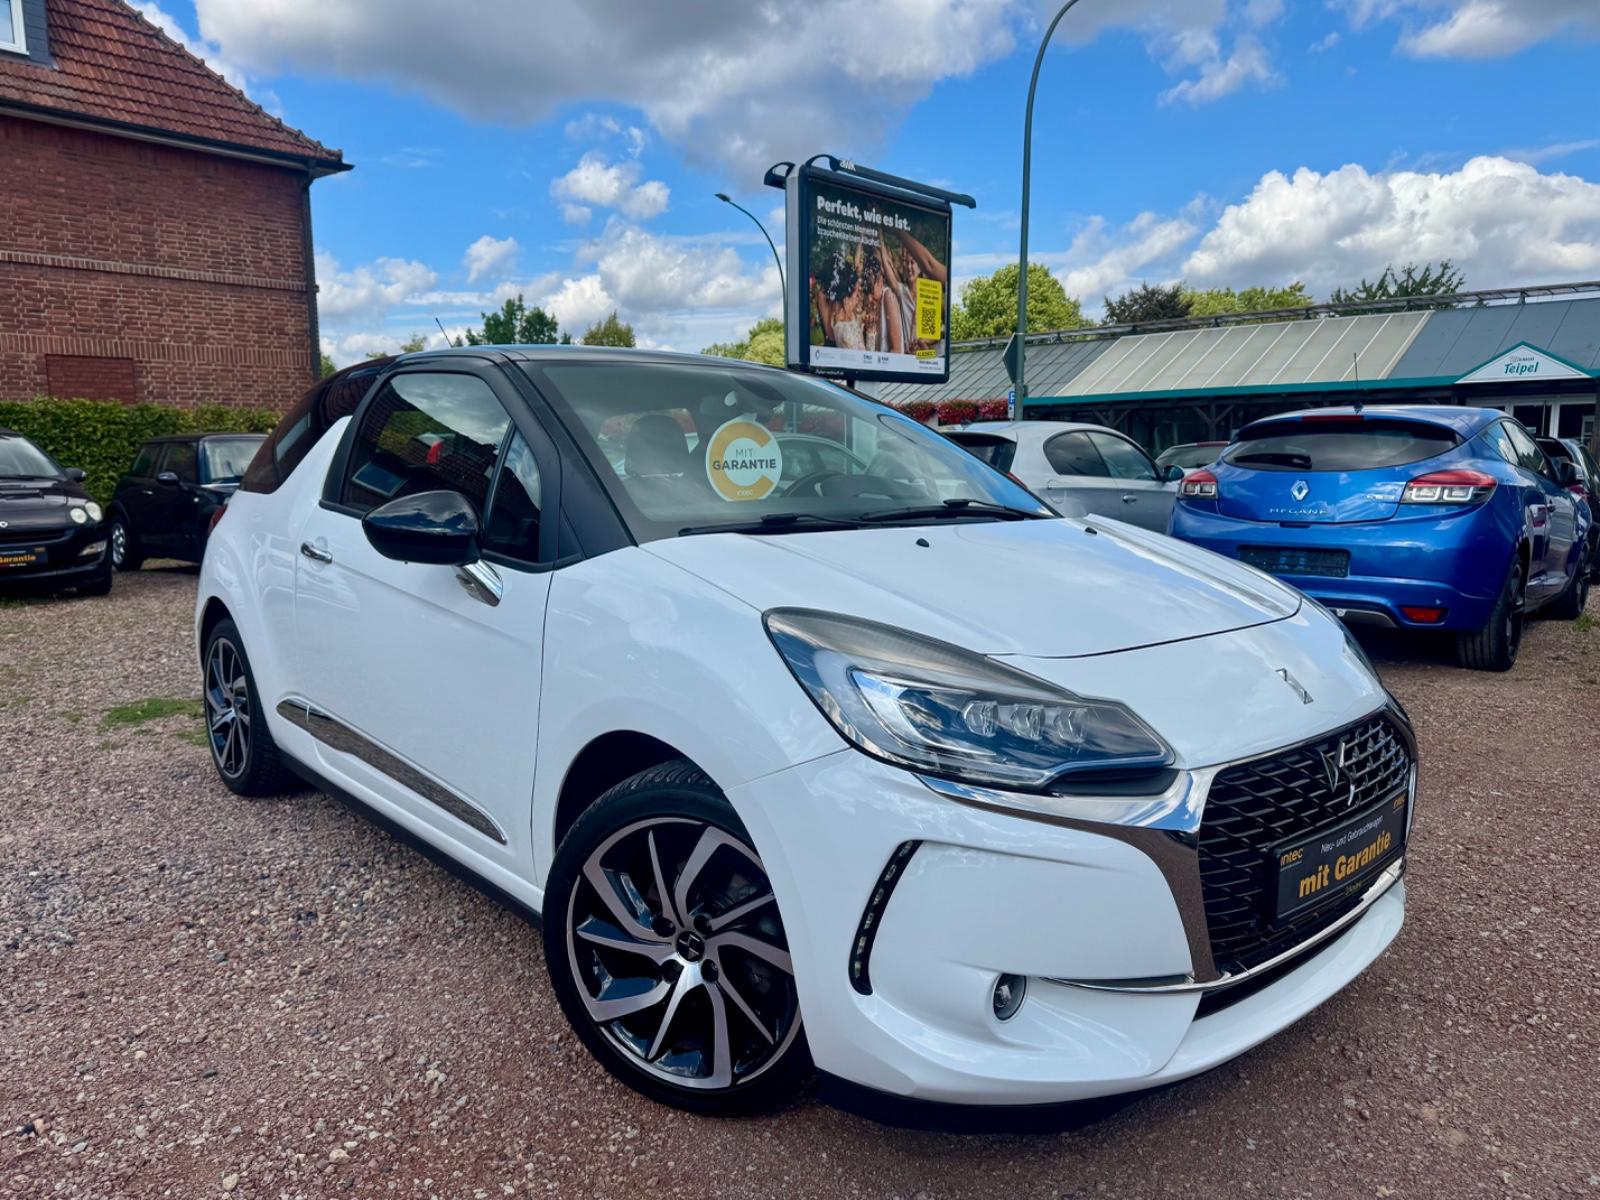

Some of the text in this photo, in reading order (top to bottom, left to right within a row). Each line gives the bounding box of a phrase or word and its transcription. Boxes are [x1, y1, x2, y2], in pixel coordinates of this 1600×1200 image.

[817, 195, 911, 231] Perfekt, wie es ist.
[1504, 361, 1539, 375] Teipel
[735, 448, 754, 458] MIT
[712, 458, 777, 471] GARANTIE
[1320, 843, 1335, 854] Neu-
[1336, 834, 1347, 847] und
[1299, 830, 1392, 898] mit Garantie
